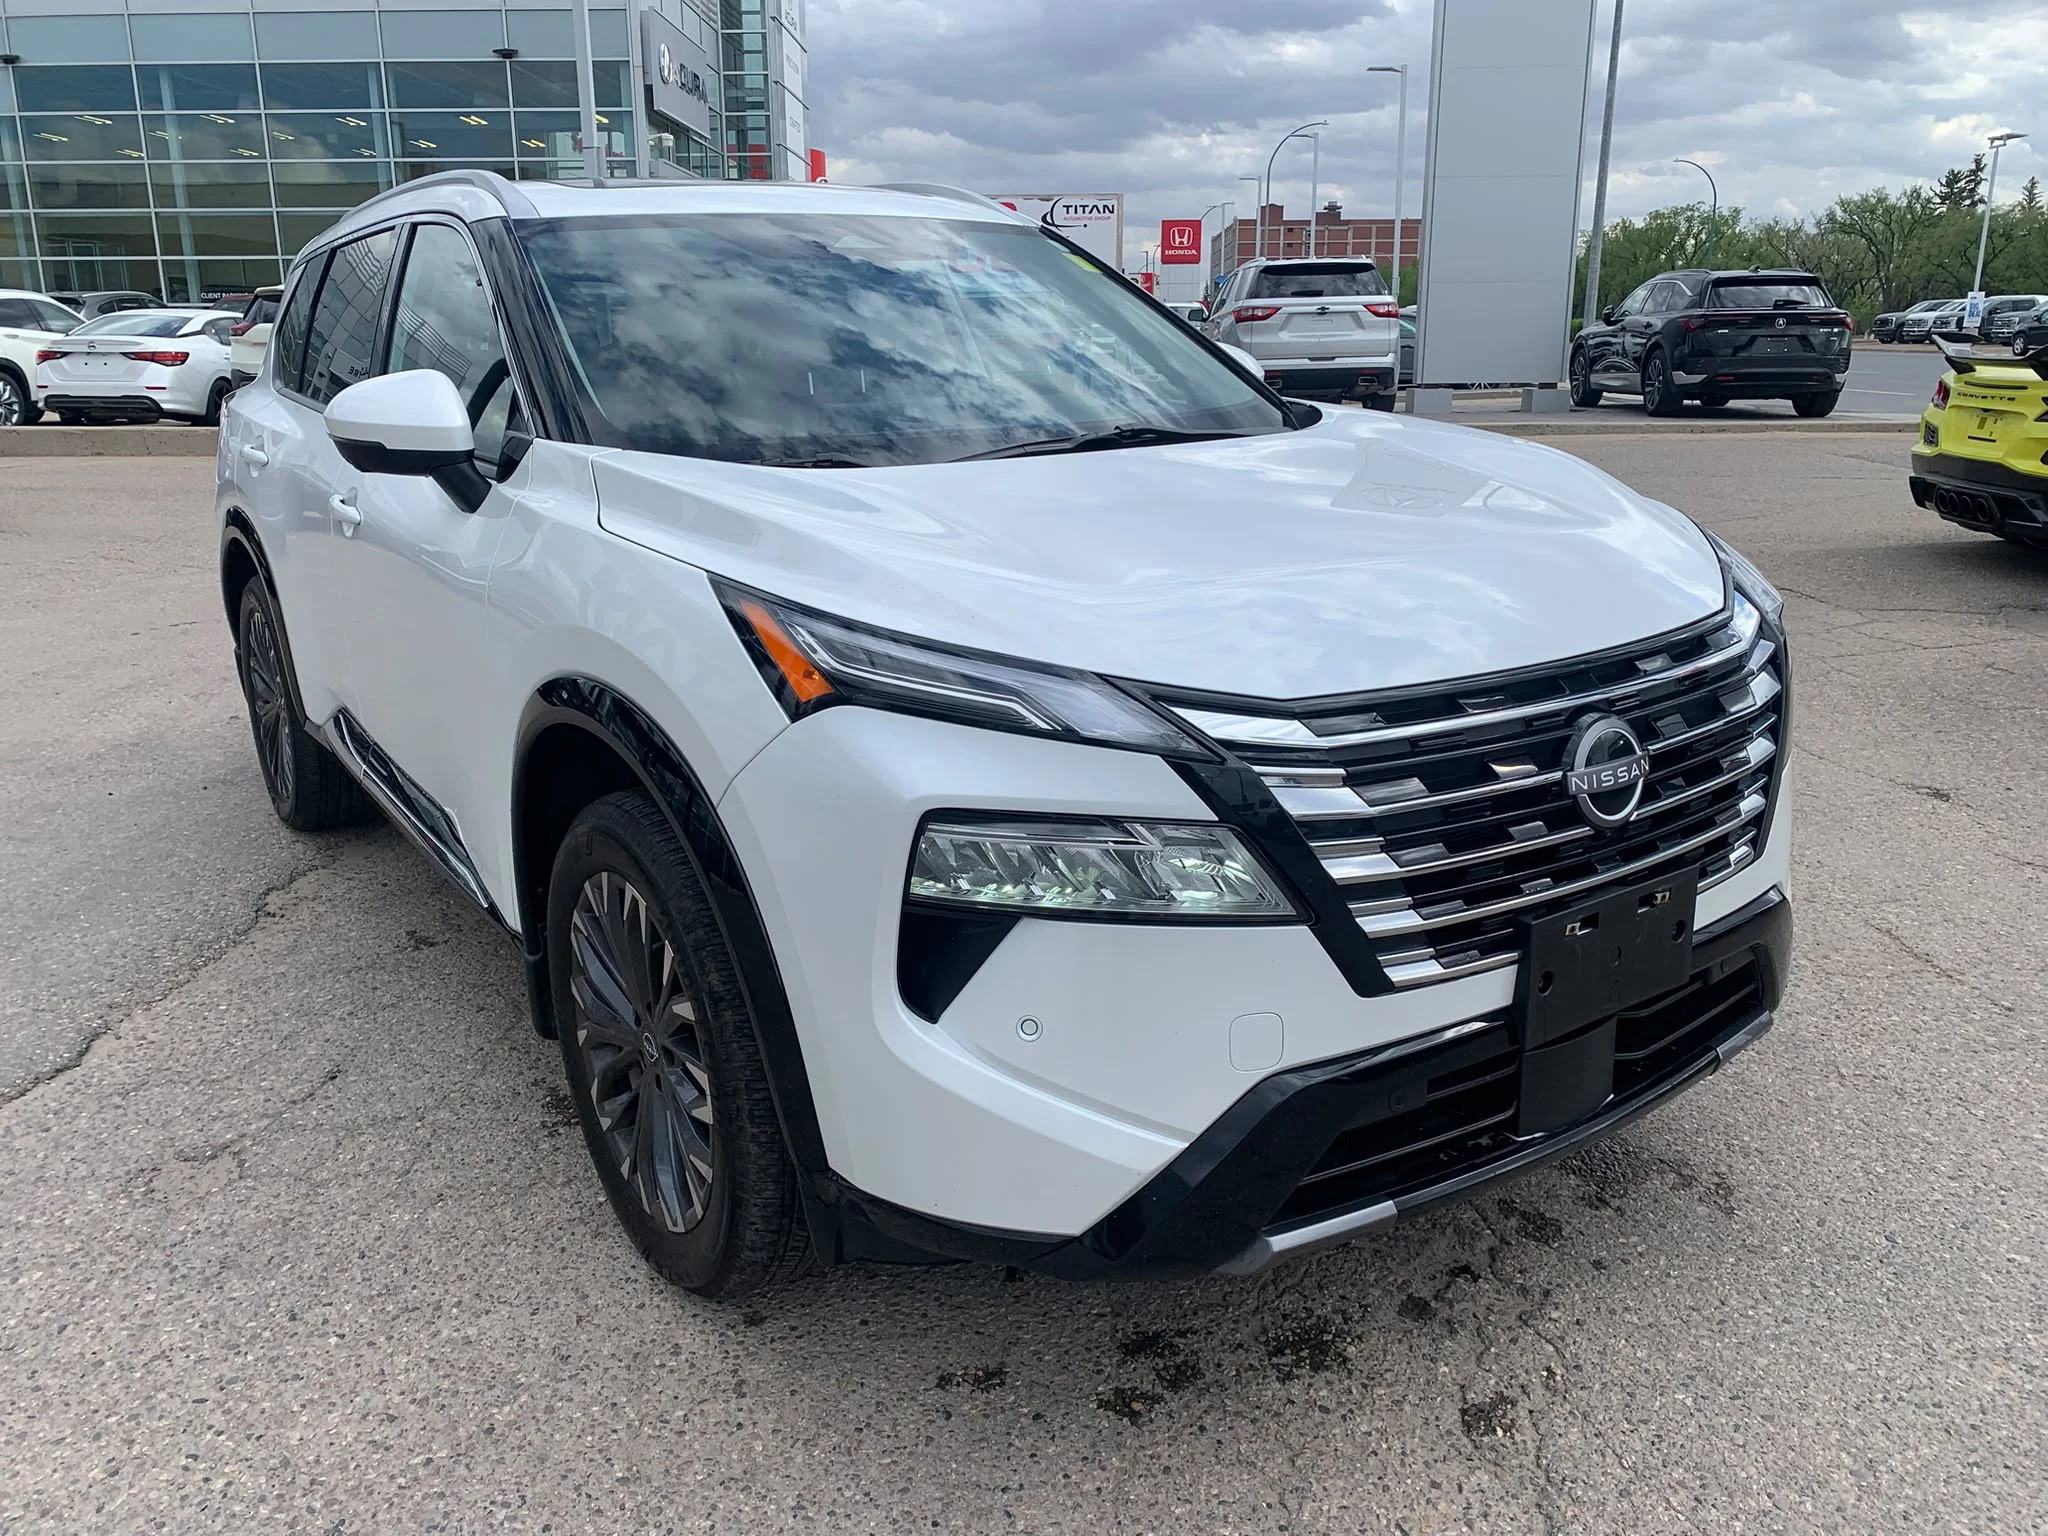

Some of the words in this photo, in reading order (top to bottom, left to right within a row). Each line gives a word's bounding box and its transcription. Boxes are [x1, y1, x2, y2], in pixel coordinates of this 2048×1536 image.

[672, 63, 708, 104] ACURA
[1062, 204, 1115, 215] TITAN
[1957, 392, 2016, 401] CORVETTE
[1571, 756, 1650, 792] NISSAN
